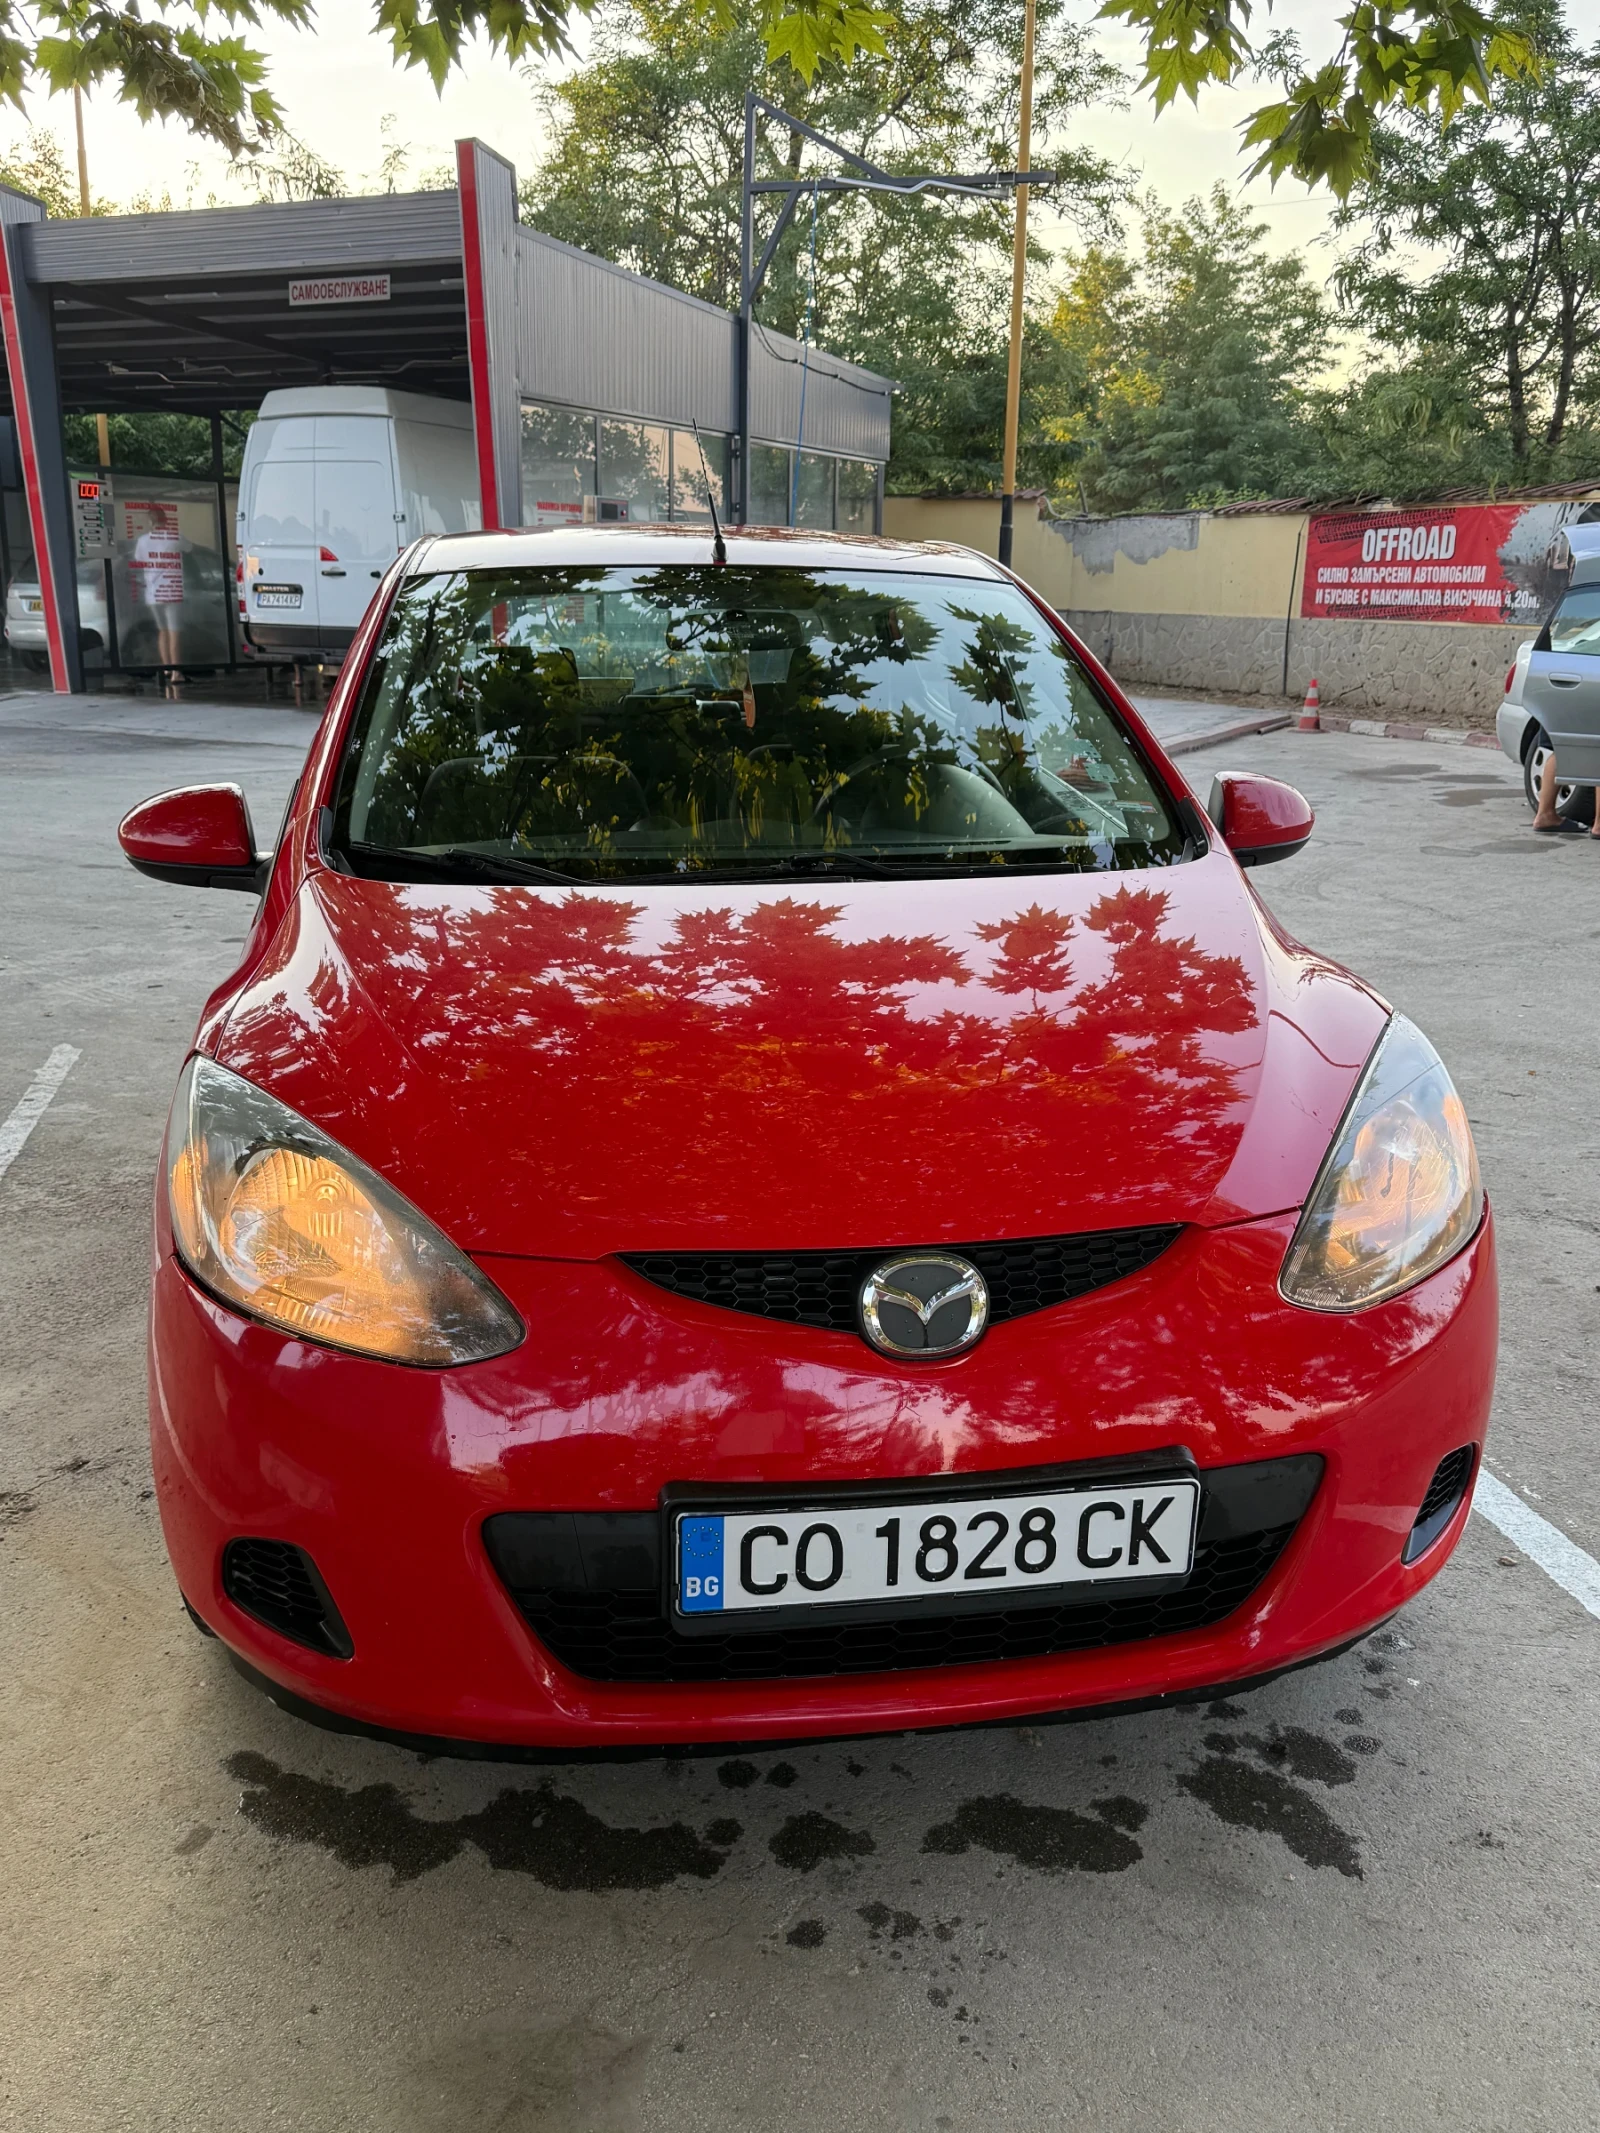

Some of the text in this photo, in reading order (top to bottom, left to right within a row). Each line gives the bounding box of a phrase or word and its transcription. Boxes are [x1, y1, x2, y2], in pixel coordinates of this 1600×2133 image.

[291, 279, 388, 301] САМООБСЛУЖВАНЕ
[1362, 524, 1457, 562] OFFROAD
[1317, 565, 1487, 583] СИЛНО ЗАМЪРСЕНИ АВТОМОБИЛИ
[1315, 589, 1324, 604] И
[1324, 589, 1360, 604] БУСОВЕ
[1361, 589, 1369, 605] С
[1370, 589, 1441, 605] МАКСИМАЛНА
[1443, 589, 1502, 607] ВИСОЧИНА
[685, 1496, 1175, 1597] BG CO 1828 CK
